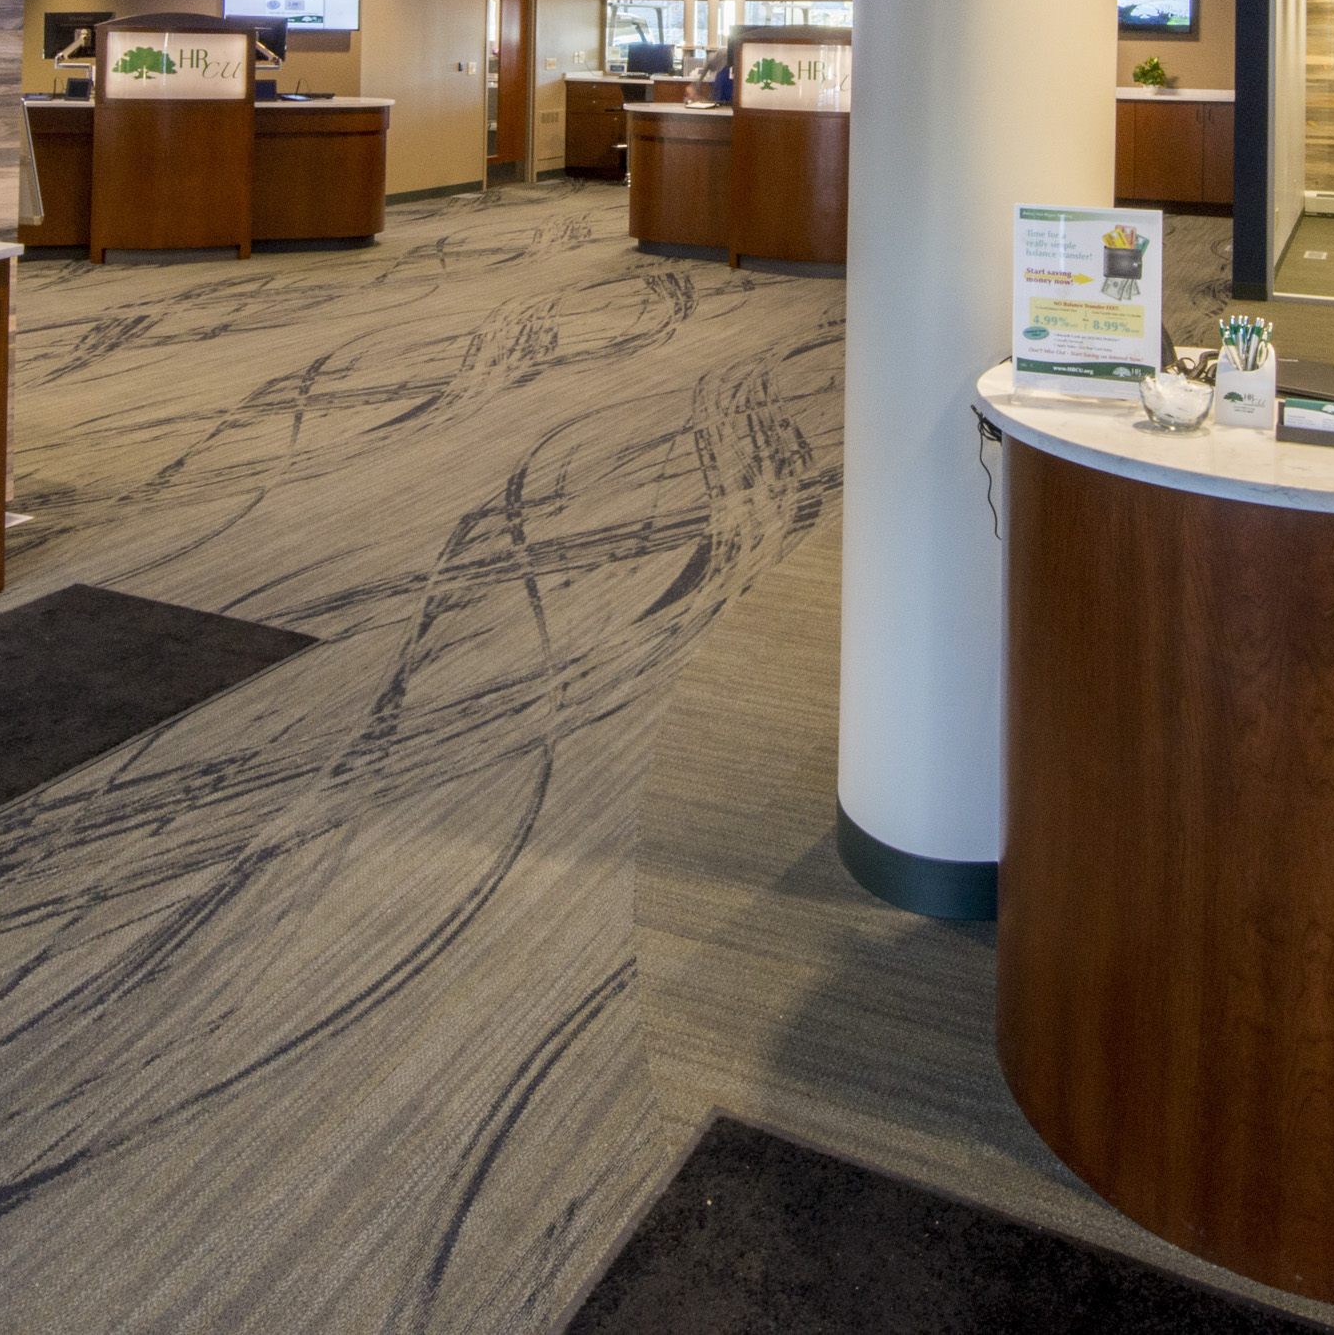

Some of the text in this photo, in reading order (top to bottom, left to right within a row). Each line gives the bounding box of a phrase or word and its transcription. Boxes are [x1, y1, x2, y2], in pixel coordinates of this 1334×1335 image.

[1048, 230, 1060, 238] for
[1026, 240, 1047, 249] really
[1059, 251, 1092, 260] ansfer!
[1026, 267, 1072, 279] Start saving
[1026, 277, 1052, 286] money
